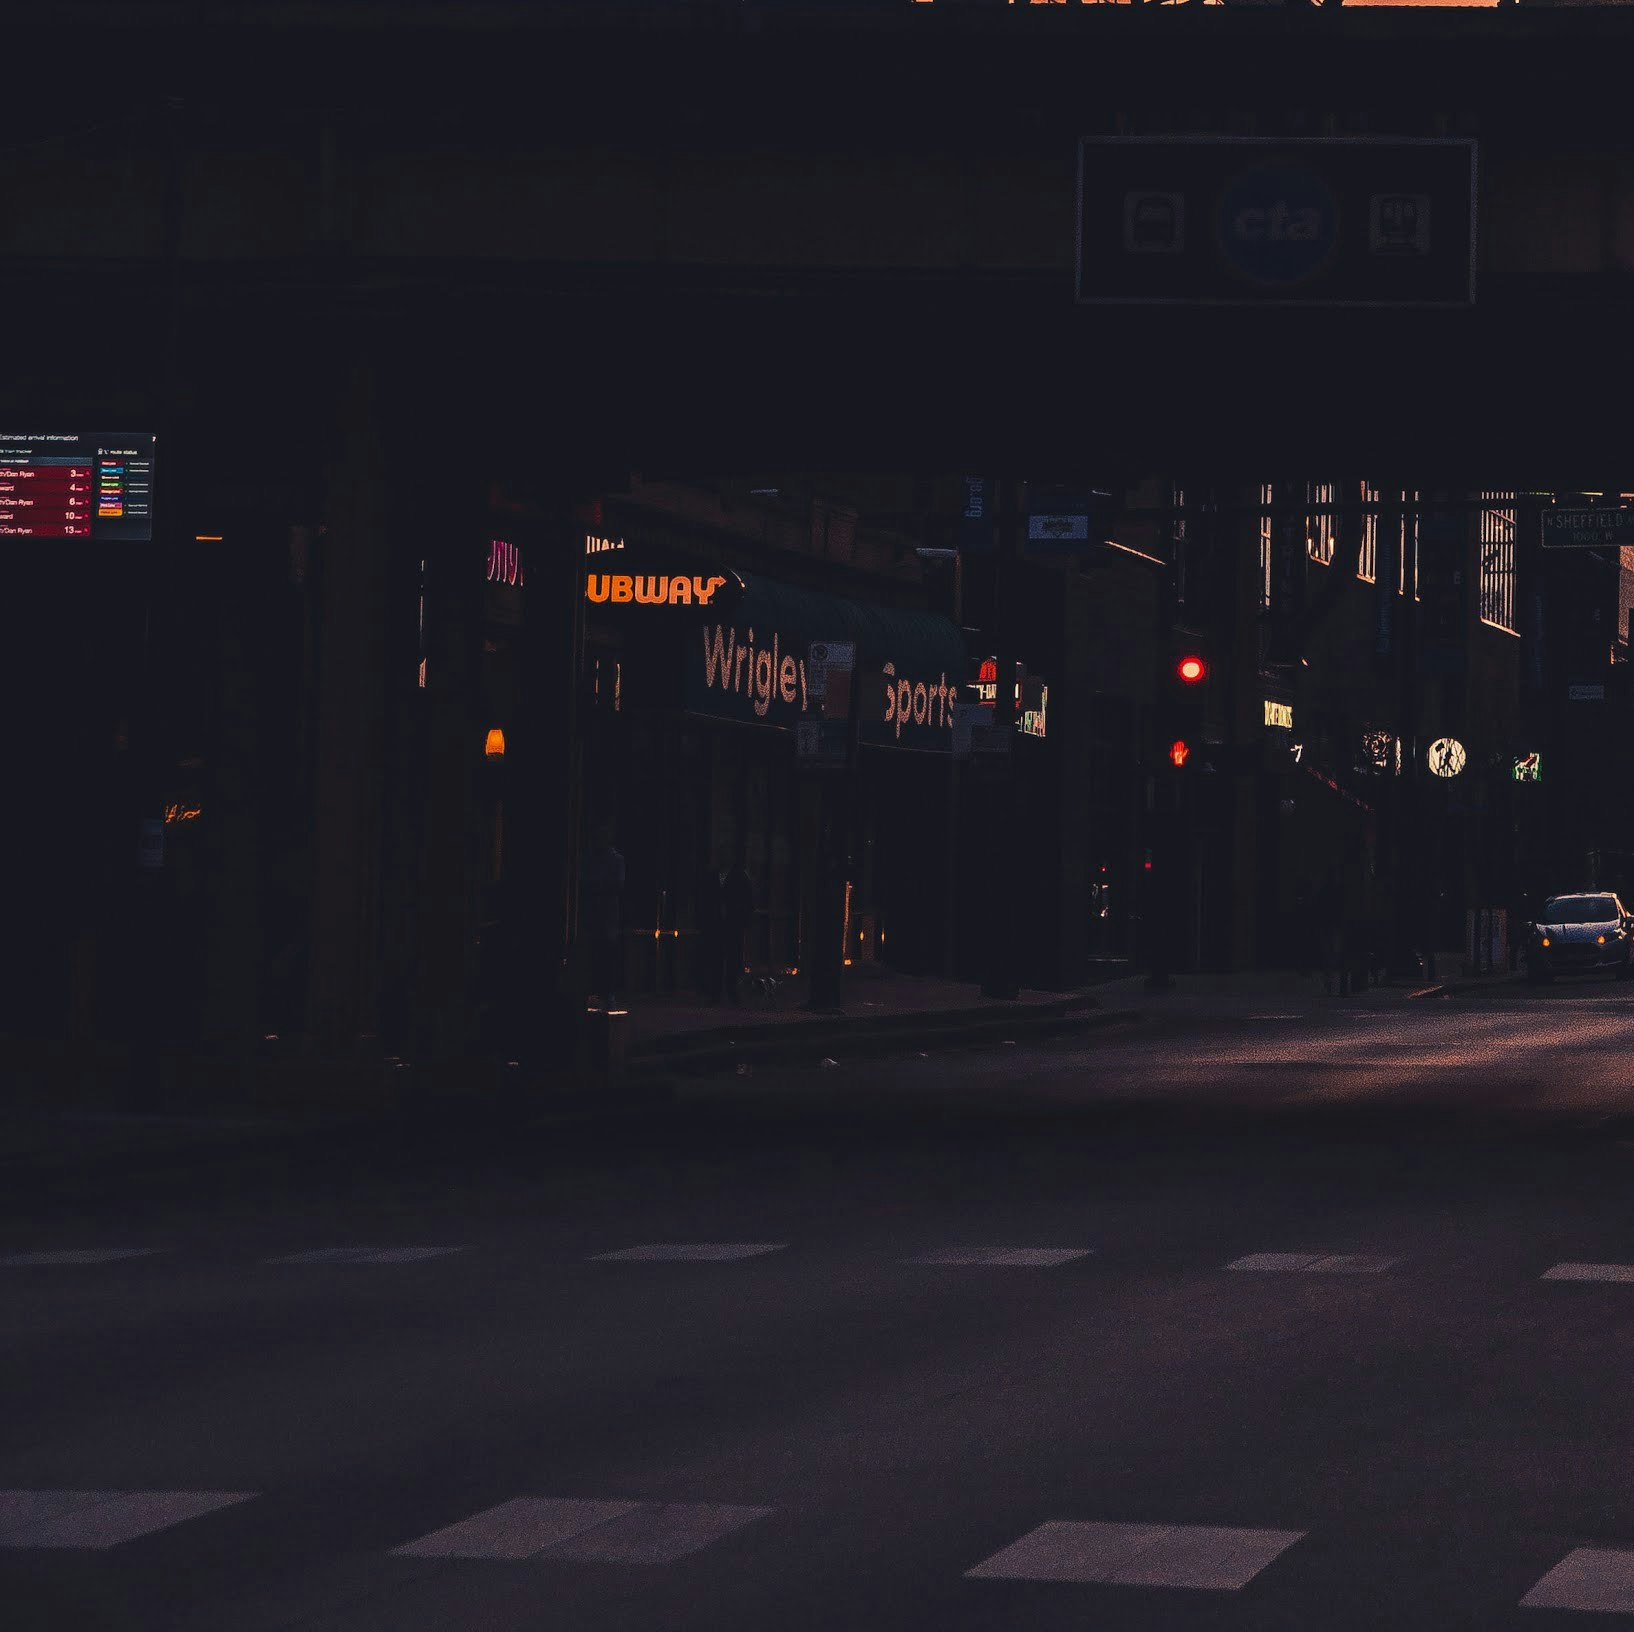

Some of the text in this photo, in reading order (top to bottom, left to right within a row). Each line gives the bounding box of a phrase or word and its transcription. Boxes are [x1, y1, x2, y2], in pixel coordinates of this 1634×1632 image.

[1234, 199, 1321, 240] cta
[70, 469, 76, 477] 3
[69, 483, 75, 492] 4
[65, 511, 75, 520] 10
[1556, 514, 1623, 529] SHEFFIELD
[64, 526, 74, 534] 13
[585, 574, 727, 605] UBWAY
